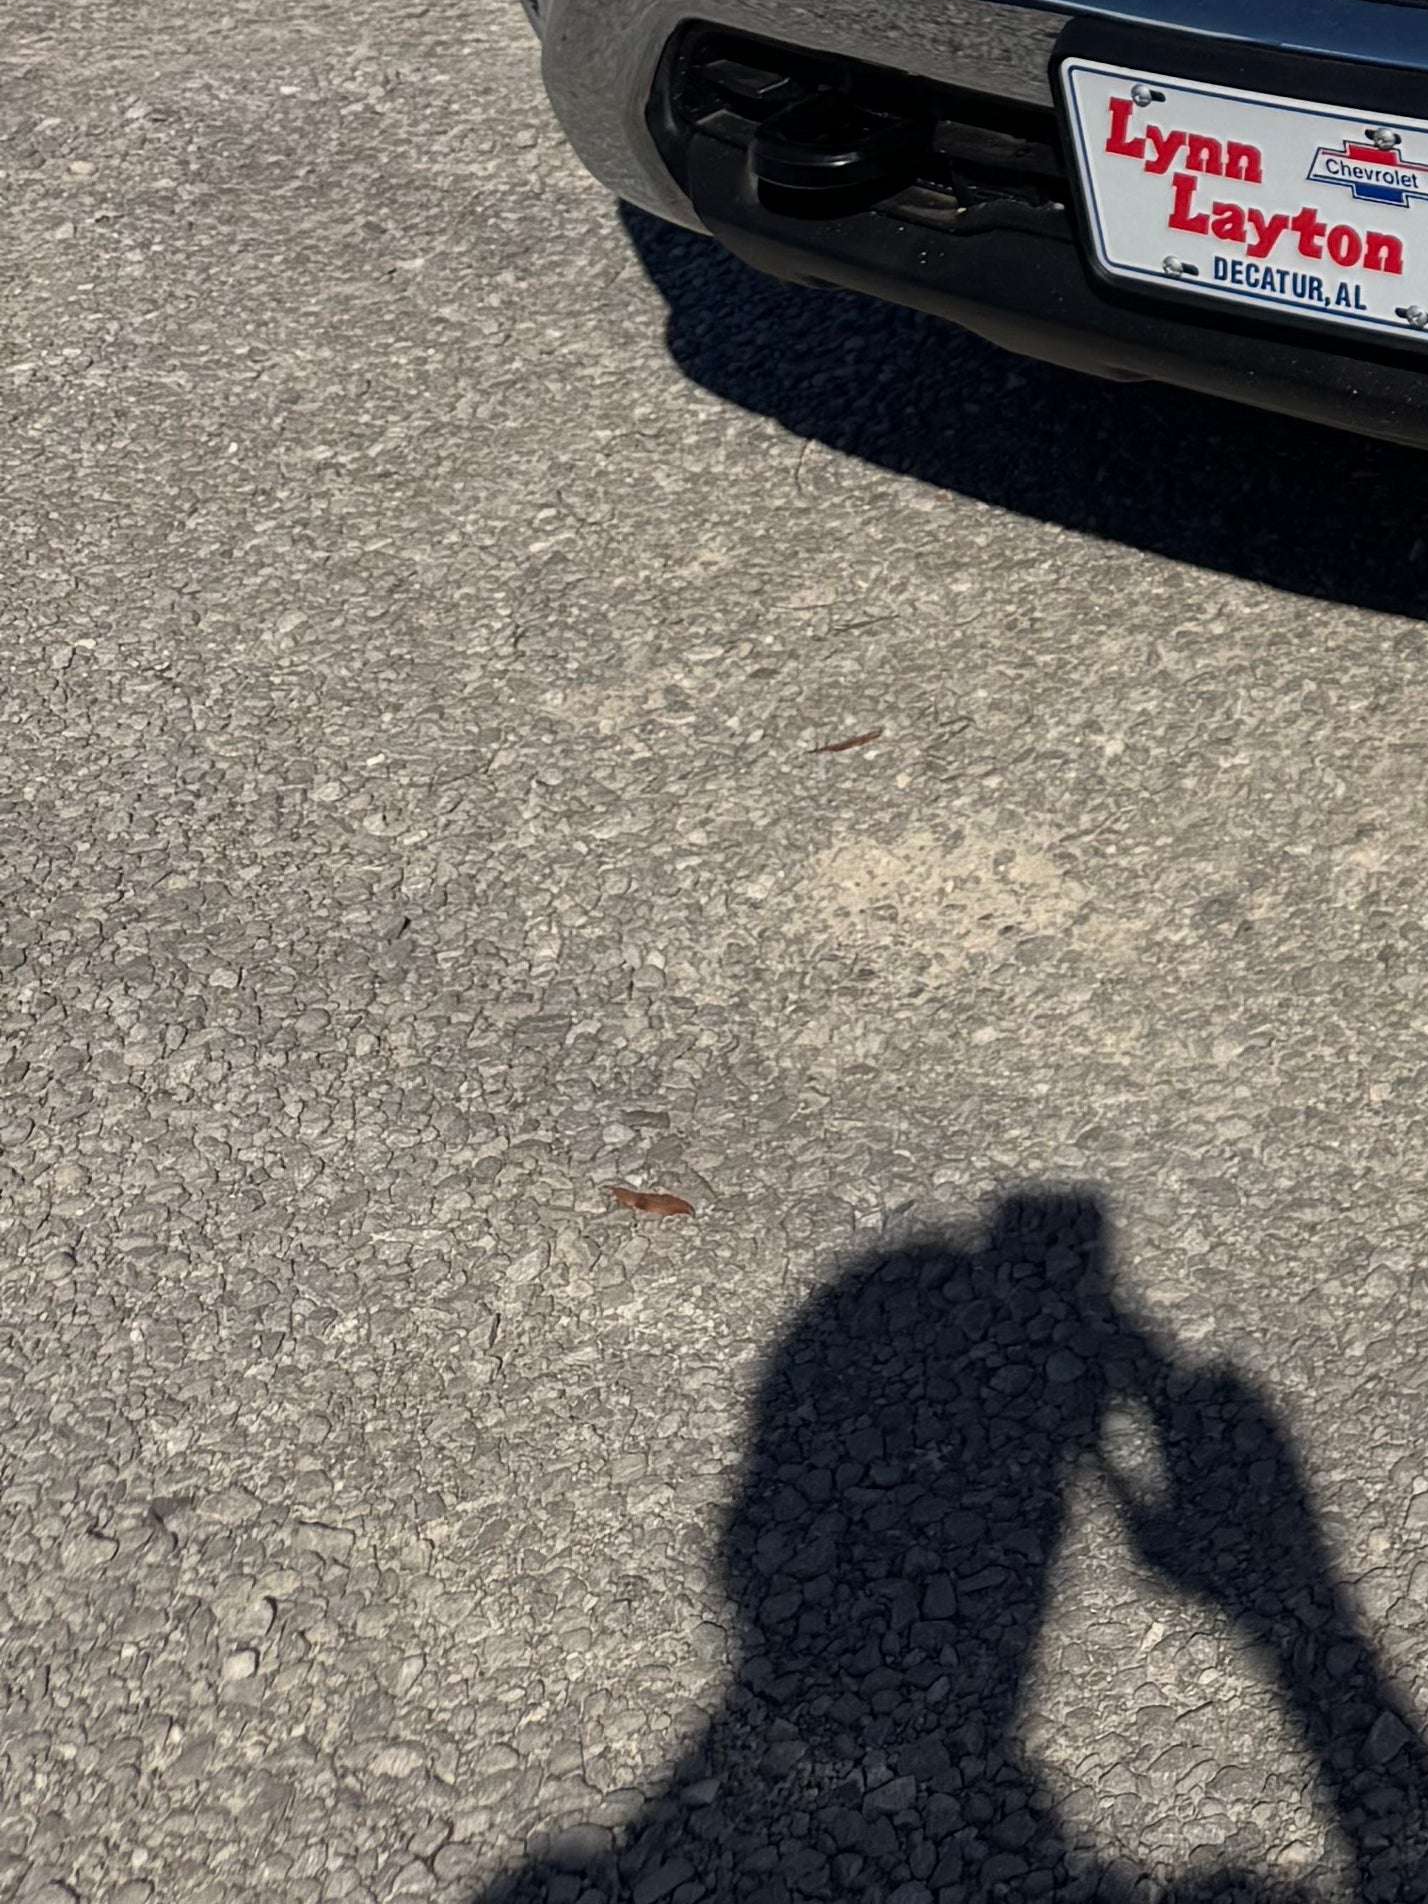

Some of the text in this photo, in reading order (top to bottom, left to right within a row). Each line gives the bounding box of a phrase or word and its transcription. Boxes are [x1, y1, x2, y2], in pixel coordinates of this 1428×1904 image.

[1105, 96, 1263, 184] Lynn
[1325, 158, 1419, 189] Chevrolet
[1168, 173, 1403, 275] Layton
